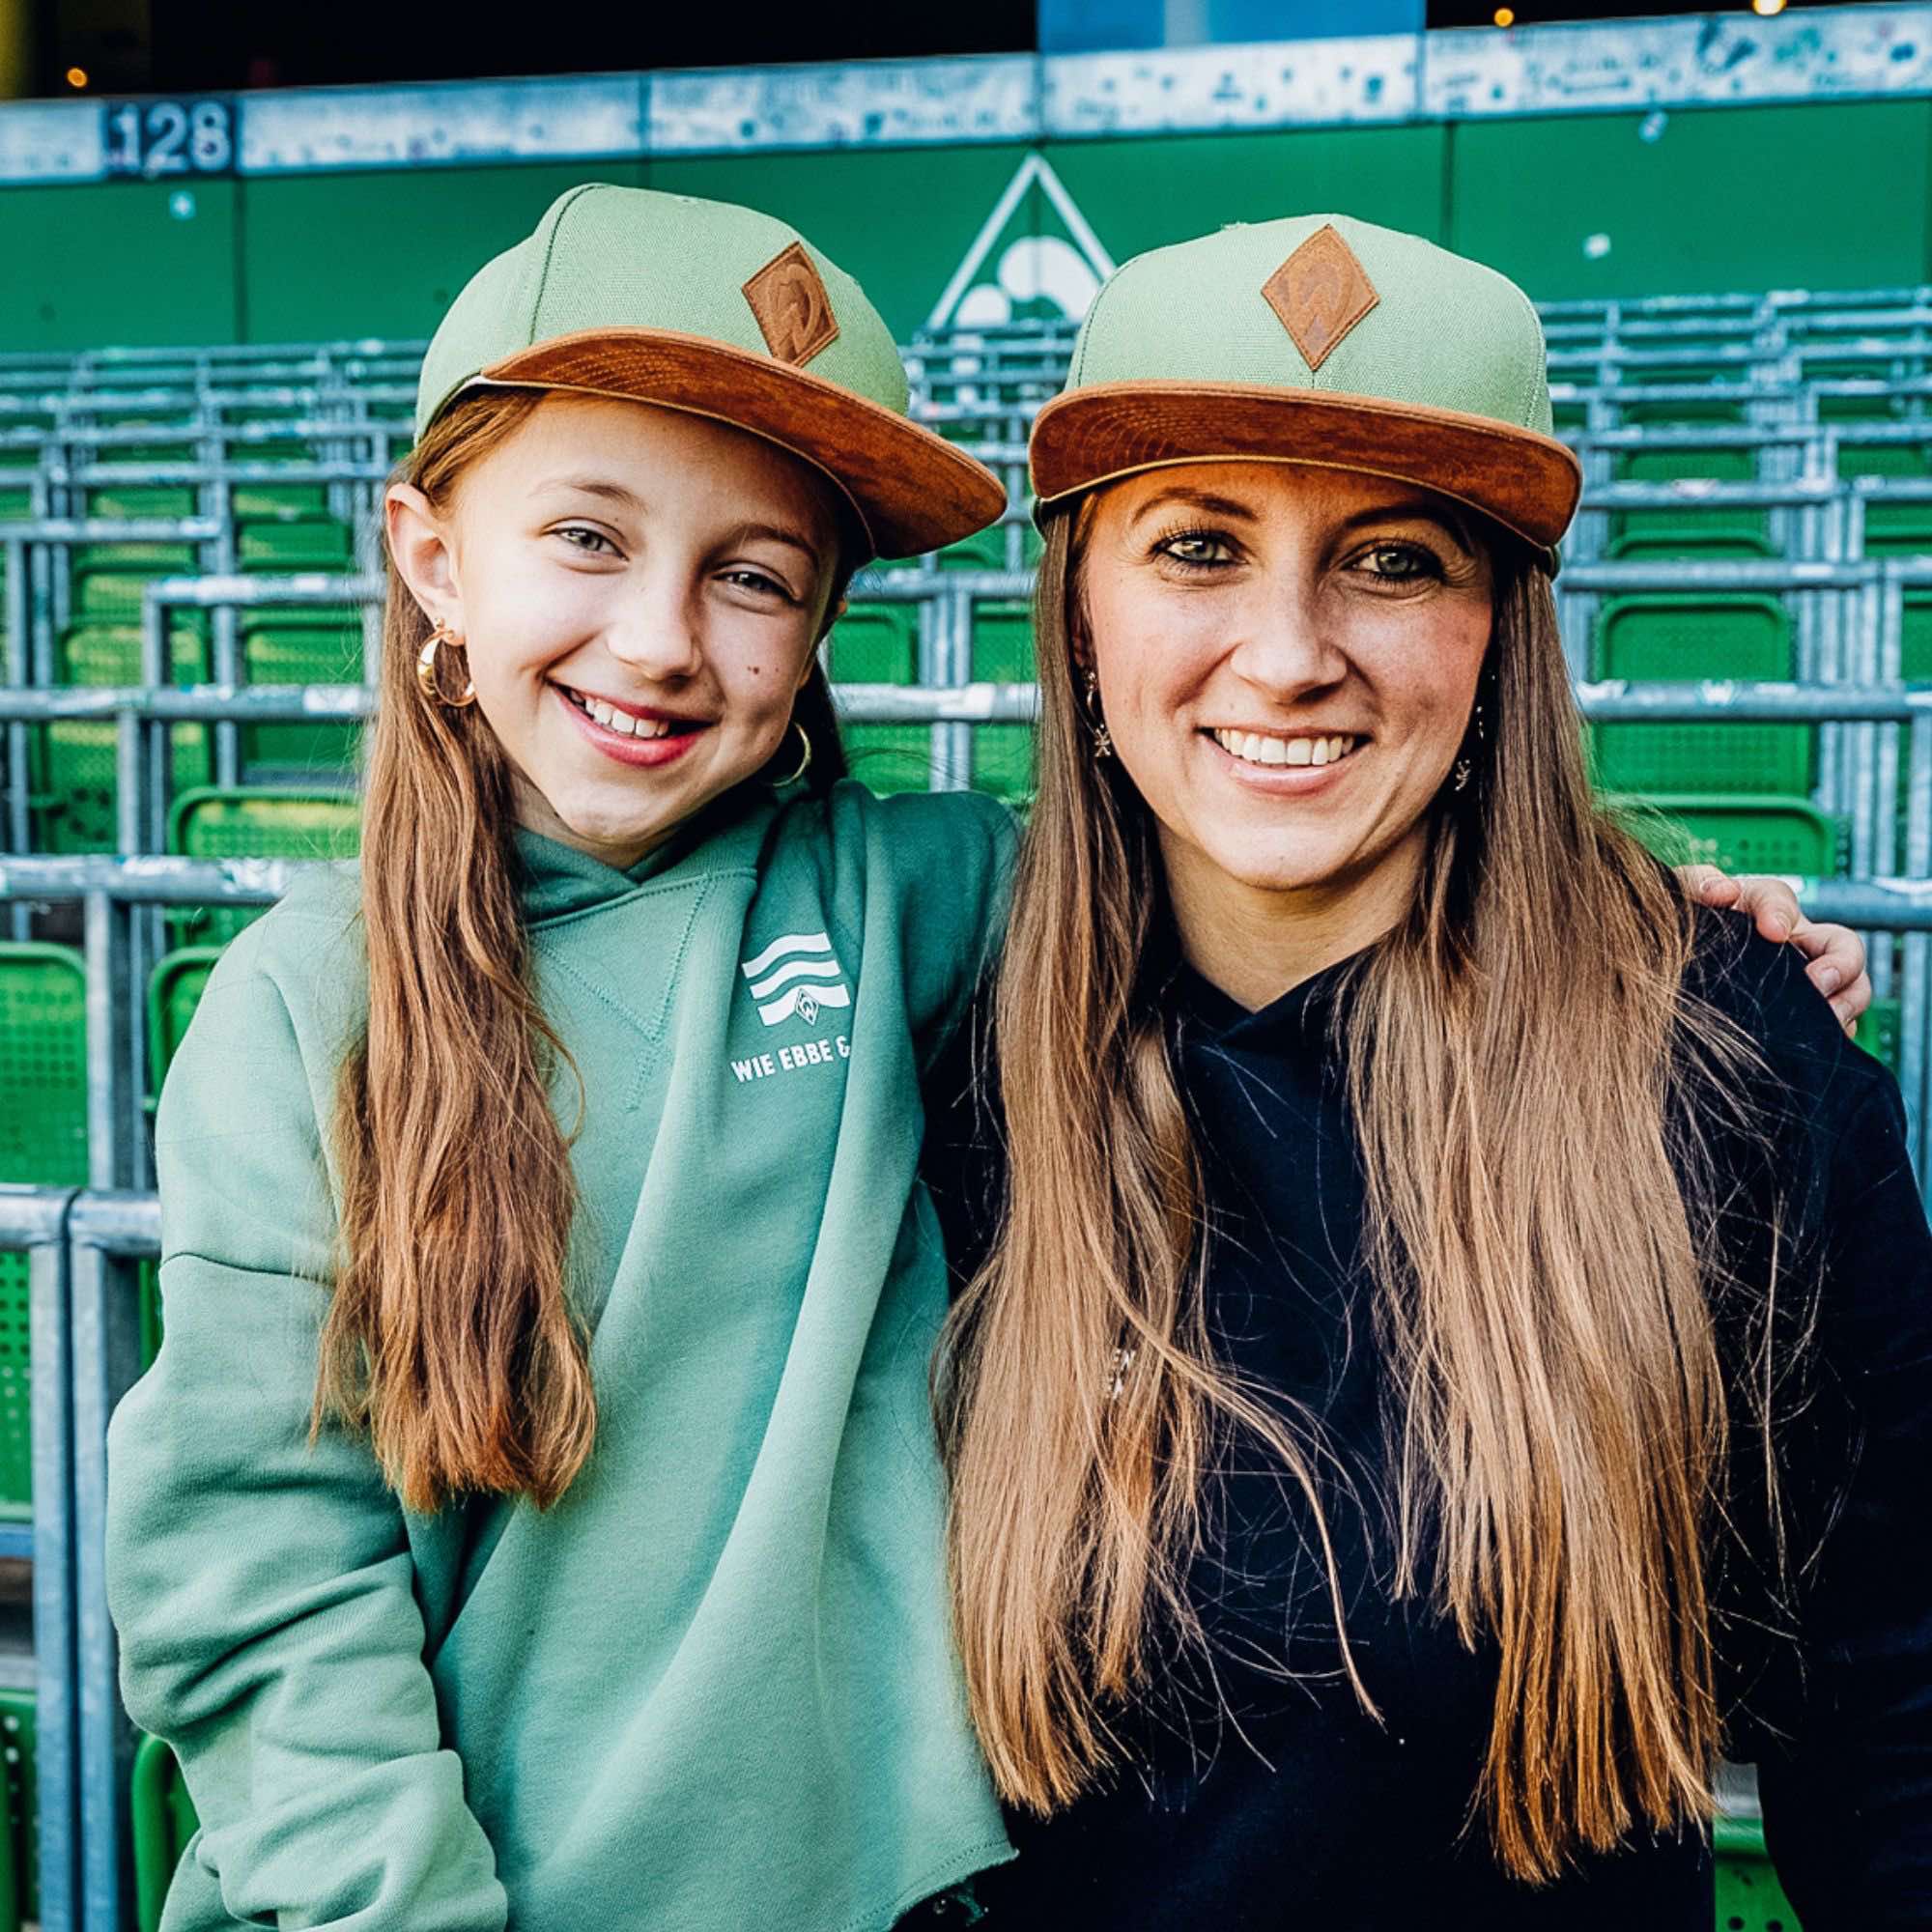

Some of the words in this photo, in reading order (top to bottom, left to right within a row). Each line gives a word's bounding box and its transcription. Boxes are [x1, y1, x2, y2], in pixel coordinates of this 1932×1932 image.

[108, 101, 230, 171] 128
[730, 1054, 776, 1083] WIE
[778, 1039, 834, 1071] EBBE
